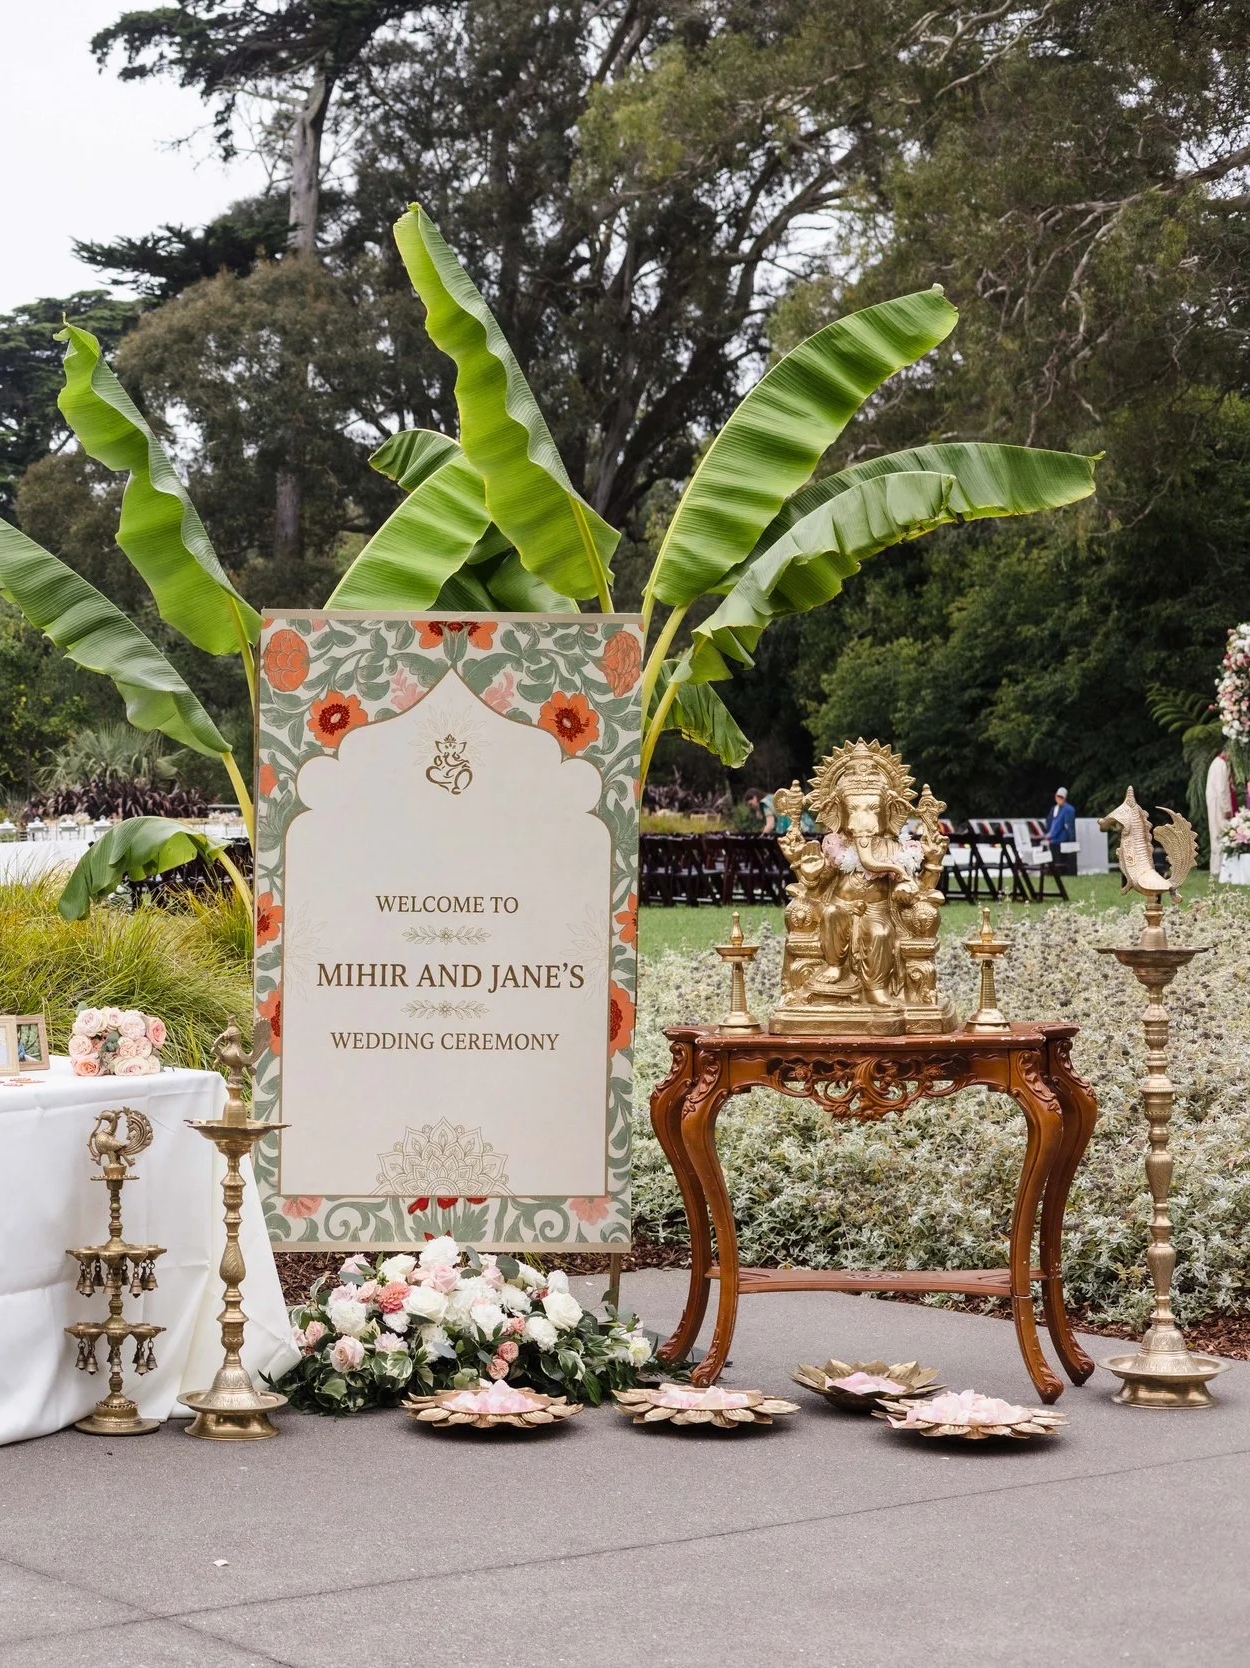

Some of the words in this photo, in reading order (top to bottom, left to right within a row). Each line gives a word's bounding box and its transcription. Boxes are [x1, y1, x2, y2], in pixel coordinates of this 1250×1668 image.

[375, 895, 485, 914] WELCOME
[490, 896, 519, 914] TO
[316, 963, 409, 988] MIHIR
[416, 964, 482, 988] AND
[488, 962, 585, 994] JANE’S
[330, 1031, 435, 1051] WEDDING
[440, 1032, 560, 1052] CEREMONY
